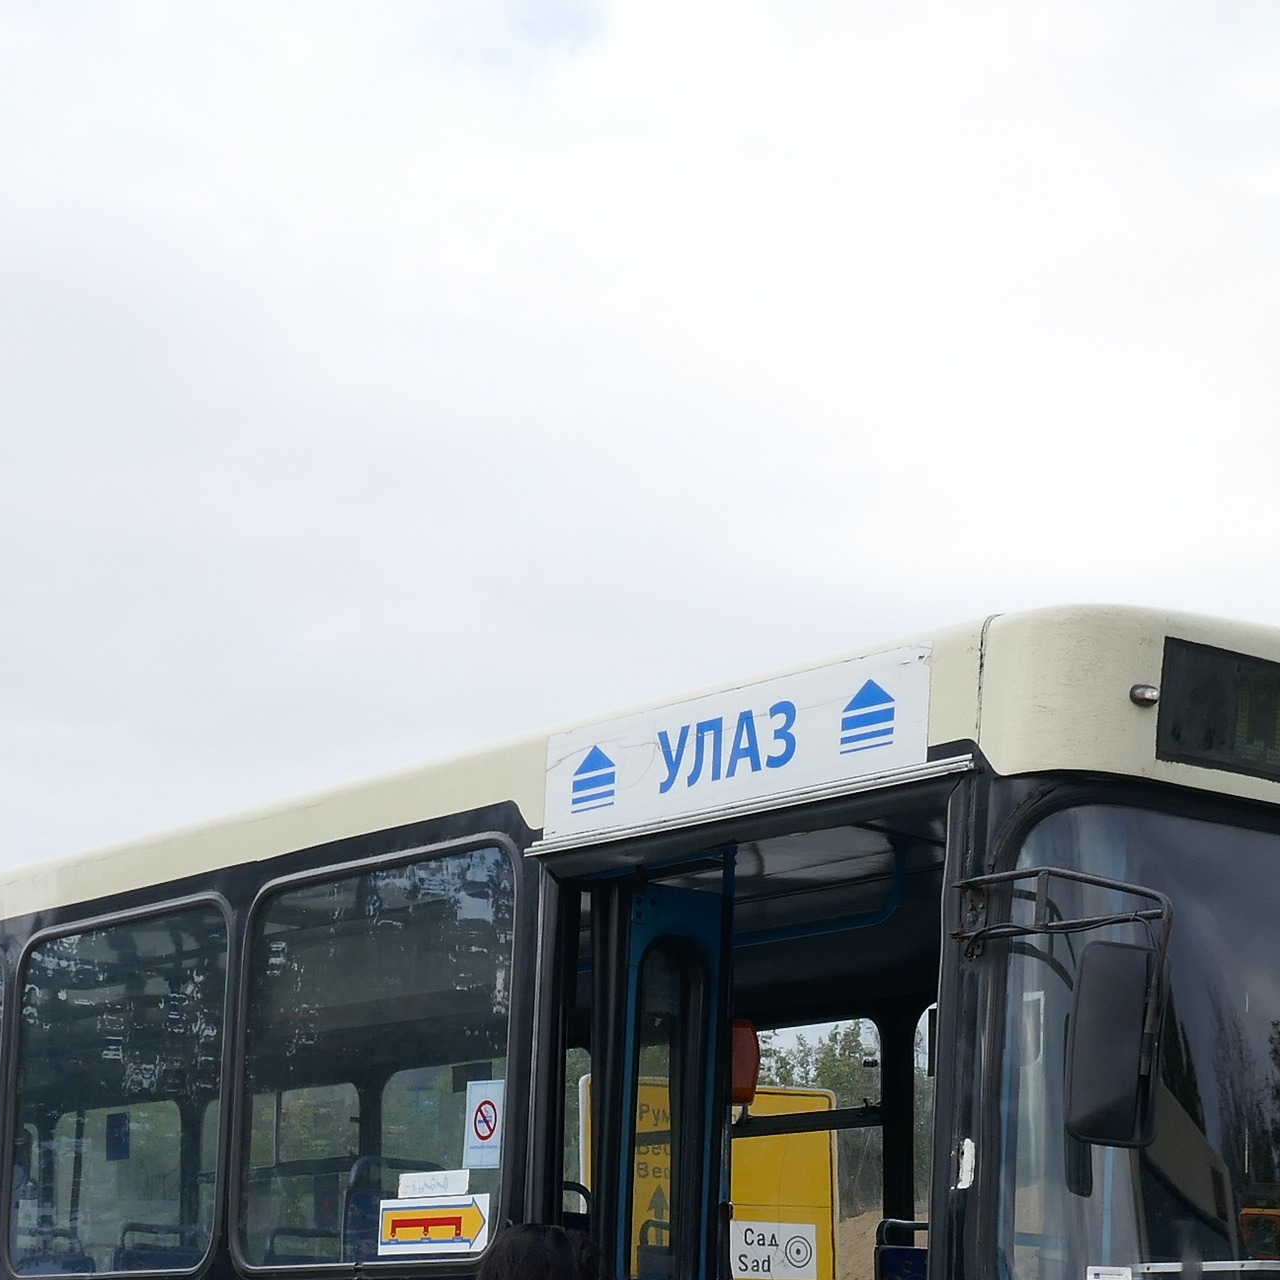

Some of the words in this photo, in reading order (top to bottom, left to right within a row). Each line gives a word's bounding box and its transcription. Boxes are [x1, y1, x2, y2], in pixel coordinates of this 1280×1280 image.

[657, 699, 797, 794] УЛАЗ
[743, 1227, 780, 1248] Сад
[738, 1254, 771, 1273] Sad
